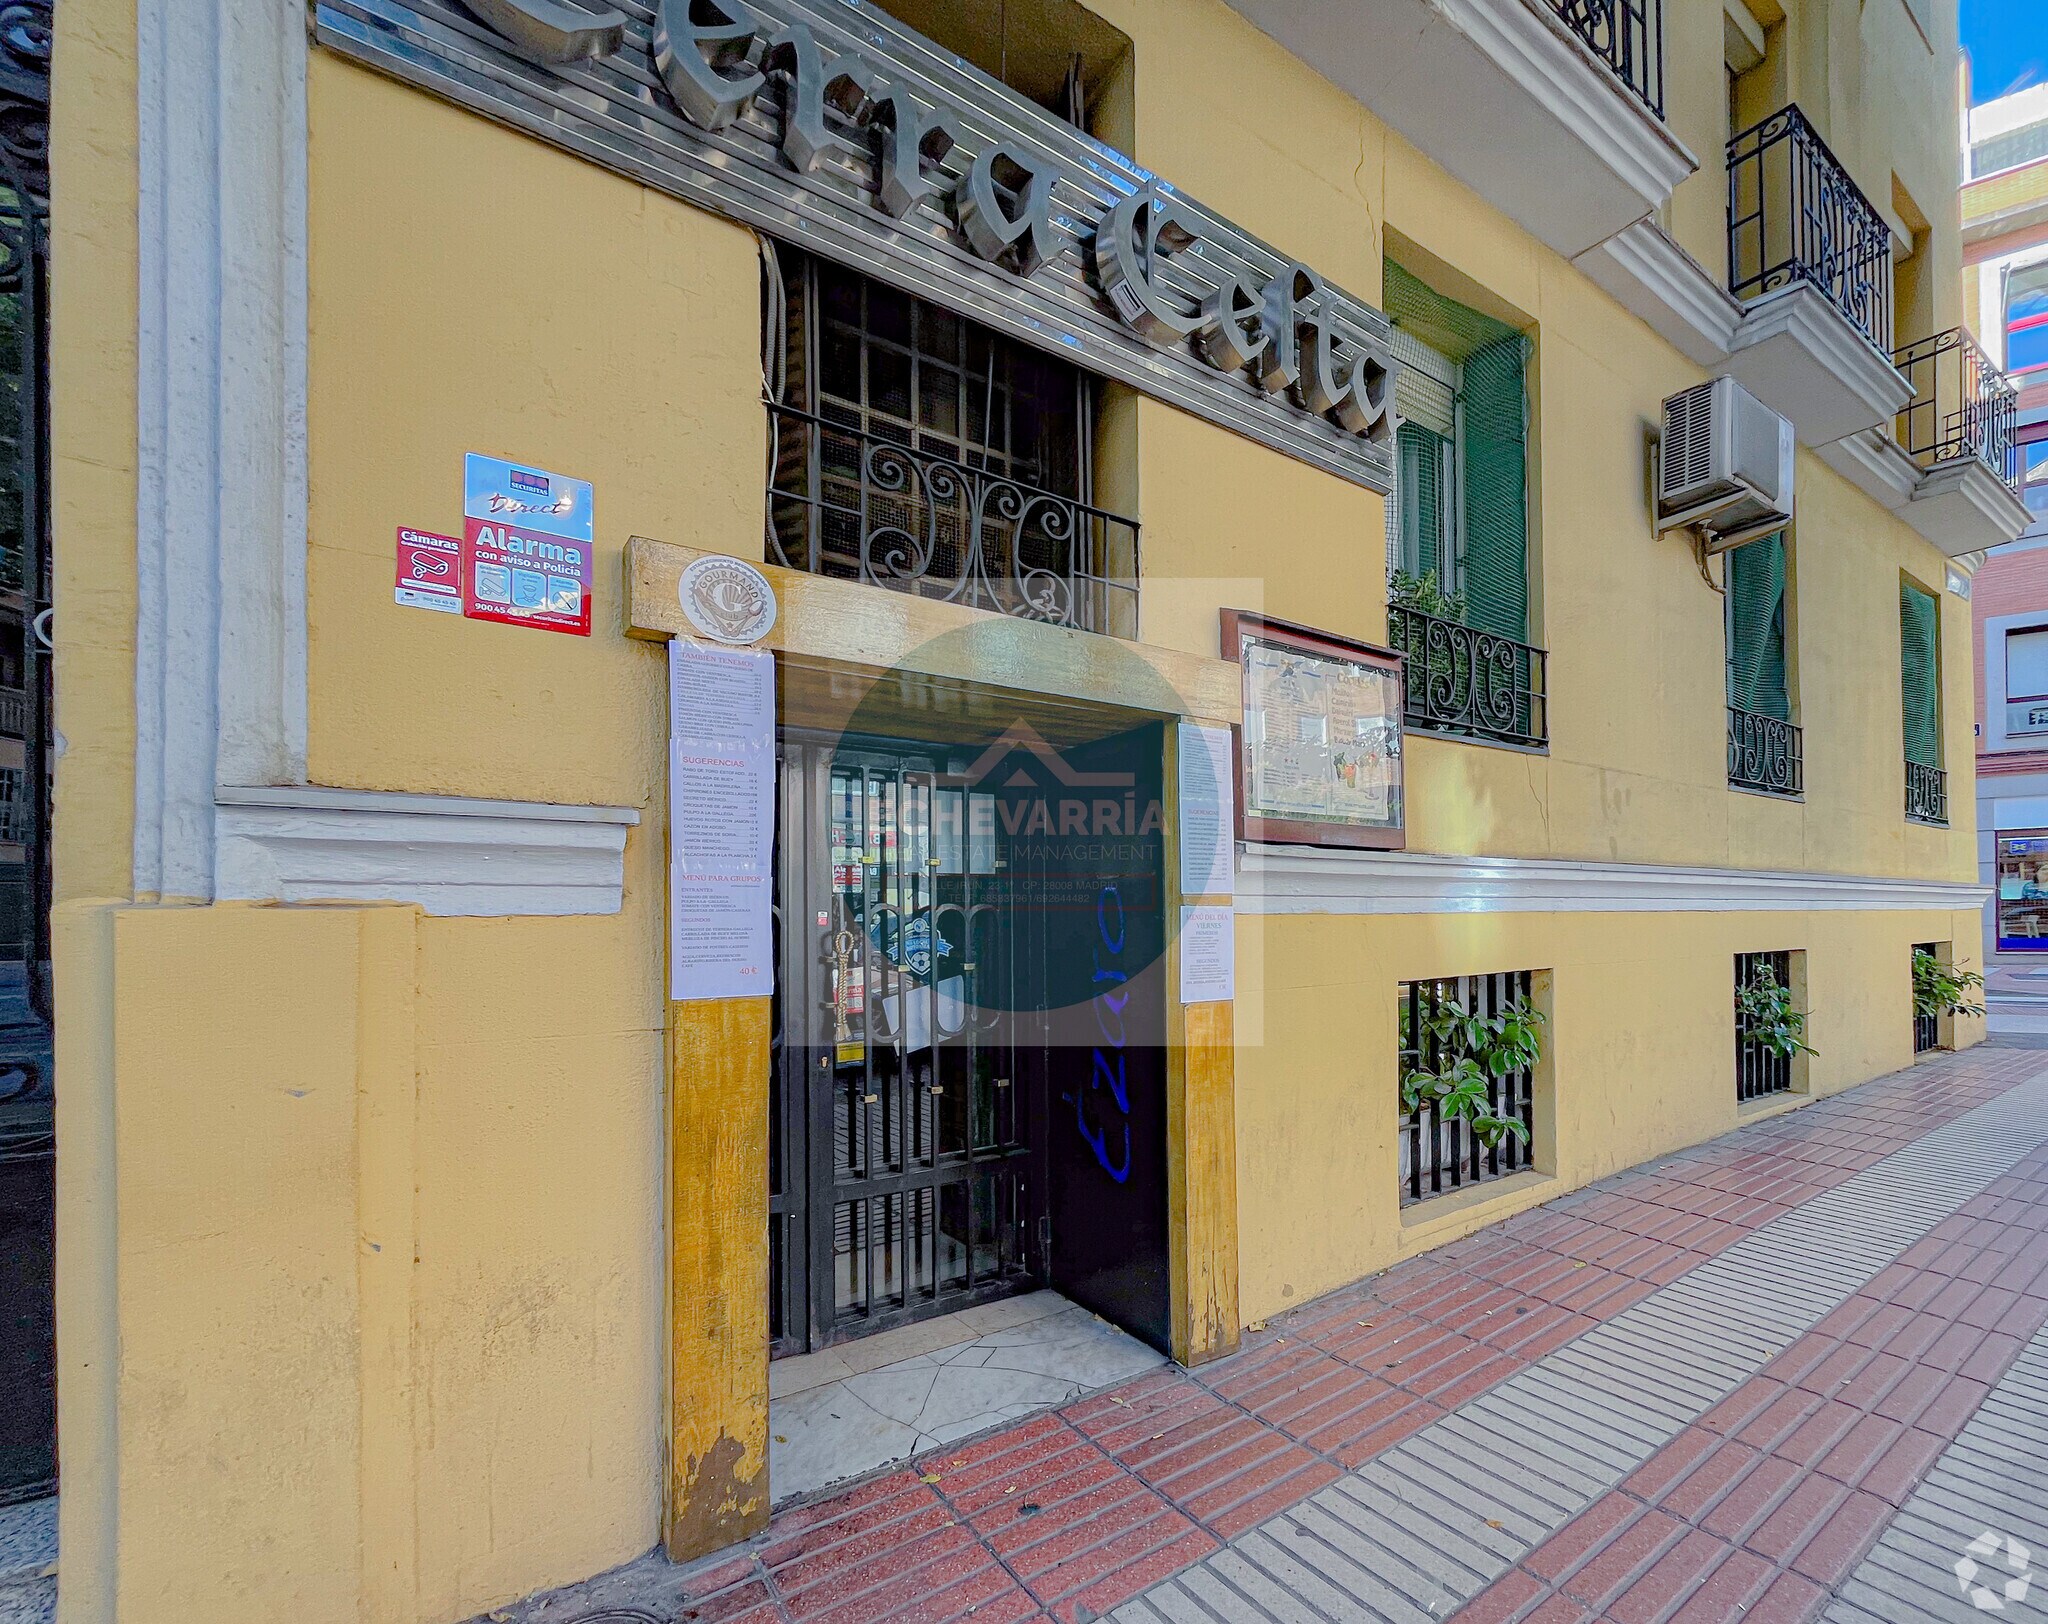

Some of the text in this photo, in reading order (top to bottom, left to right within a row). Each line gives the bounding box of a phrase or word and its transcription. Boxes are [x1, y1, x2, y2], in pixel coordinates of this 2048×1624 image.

[1096, 177, 1407, 443] Celta
[511, 481, 548, 496] SECURITAS
[400, 530, 459, 550] Cámaras
[475, 525, 582, 566] Alarma
[475, 549, 581, 577] con aviso a Policía
[699, 570, 760, 599] GOURMAND
[474, 602, 493, 612] 900
[494, 605, 506, 614] 45
[682, 756, 745, 768] SUGERENCIAS
[682, 873, 707, 881] MENÚ
[739, 966, 758, 975] 40 €
